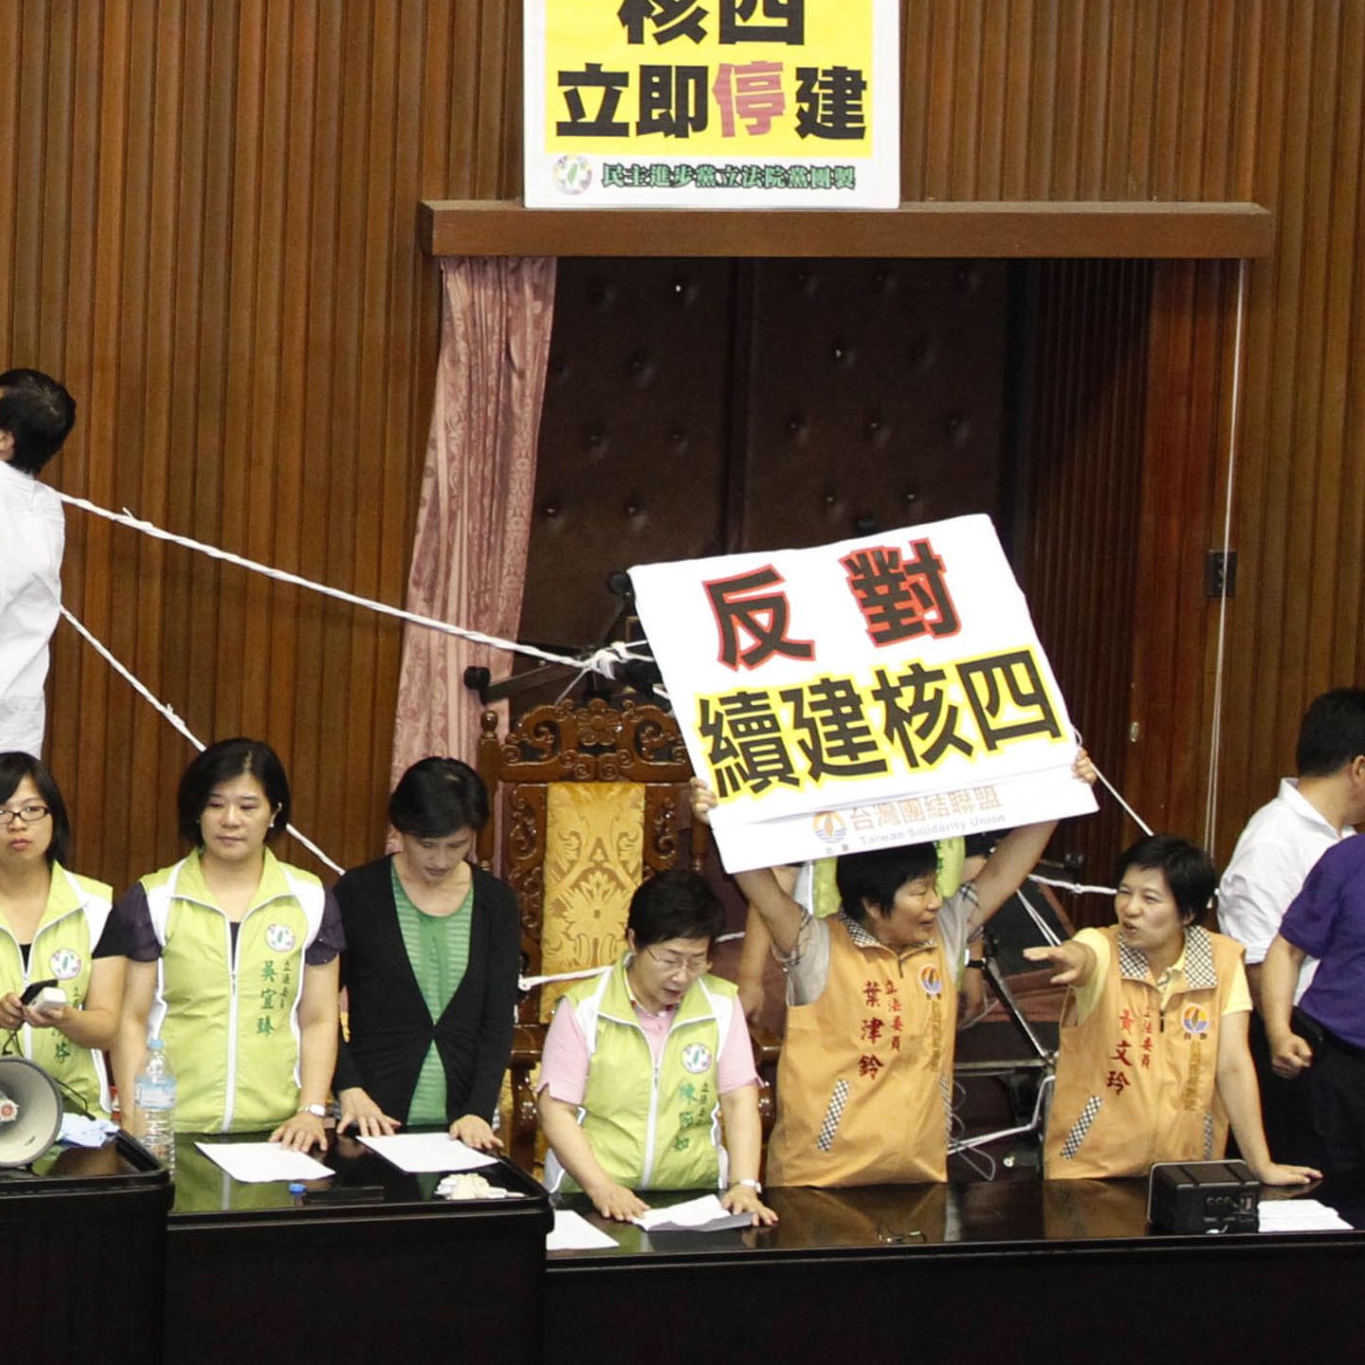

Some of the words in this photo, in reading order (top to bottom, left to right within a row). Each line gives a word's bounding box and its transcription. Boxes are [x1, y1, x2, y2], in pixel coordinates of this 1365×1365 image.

[556, 60, 868, 141] 立即停建
[602, 162, 856, 191] 民主進步黨立法院黨團製
[702, 538, 962, 672] 反對
[696, 647, 1064, 801] 續建核四
[850, 785, 1002, 831] 台灣團結聯盟
[860, 831, 905, 845] Taiwan
[908, 821, 967, 838] Solidarity
[971, 813, 1006, 827] Union
